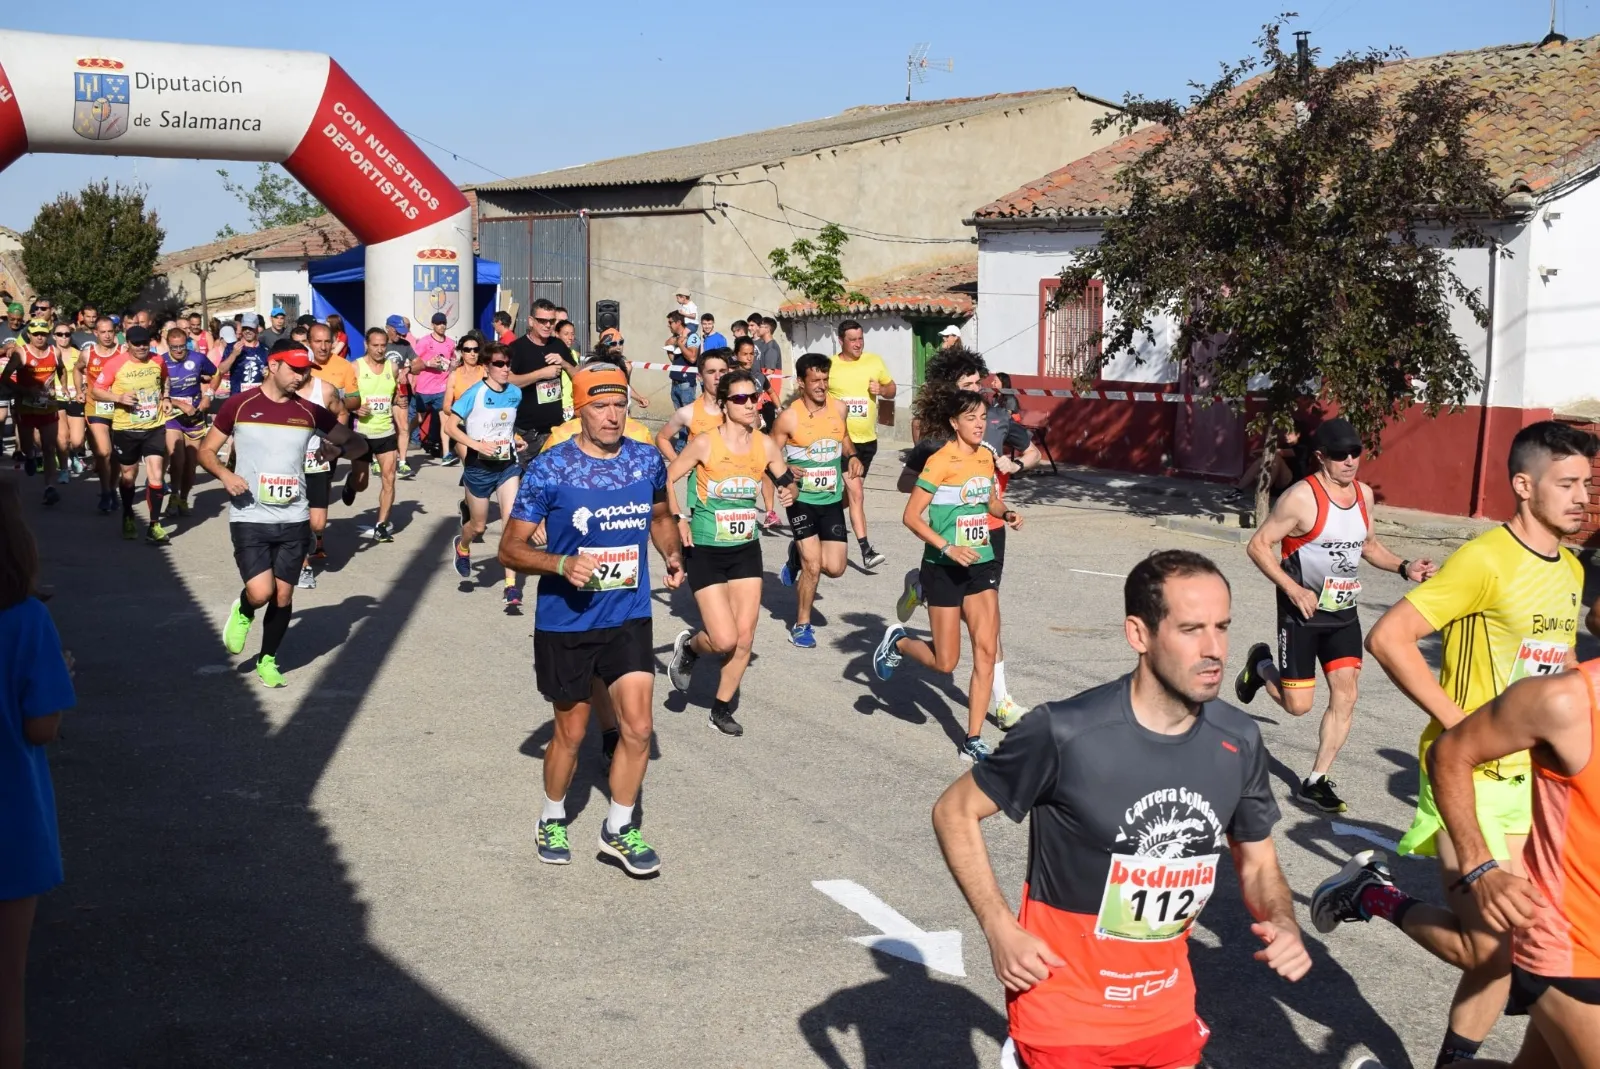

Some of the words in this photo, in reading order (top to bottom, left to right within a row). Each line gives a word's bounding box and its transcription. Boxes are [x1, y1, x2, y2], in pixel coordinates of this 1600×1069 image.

[135, 72, 243, 95] Diputación
[133, 113, 152, 128] de
[159, 110, 262, 132] Salamanca
[333, 101, 367, 136] CON
[364, 133, 440, 211] NUESTROS
[322, 122, 420, 220] DEPORTISTAS
[691, 336, 698, 344] 3
[546, 387, 557, 398] 69
[139, 409, 151, 419] 23
[373, 402, 385, 411] 20
[811, 446, 837, 455] ALCER
[260, 474, 298, 486] bedunia
[814, 476, 828, 488] 90
[268, 485, 292, 498] 115
[721, 486, 757, 495] ALCER
[594, 501, 652, 522] apaches
[715, 511, 757, 522] bedunia
[599, 516, 647, 532] running
[729, 521, 746, 535] 50
[964, 526, 985, 541] 105
[598, 563, 622, 581] 94
[1532, 613, 1559, 635] RUN
[1125, 787, 1178, 825] Carrera
[1109, 860, 1214, 889] bedunia
[1131, 889, 1195, 922] 112
